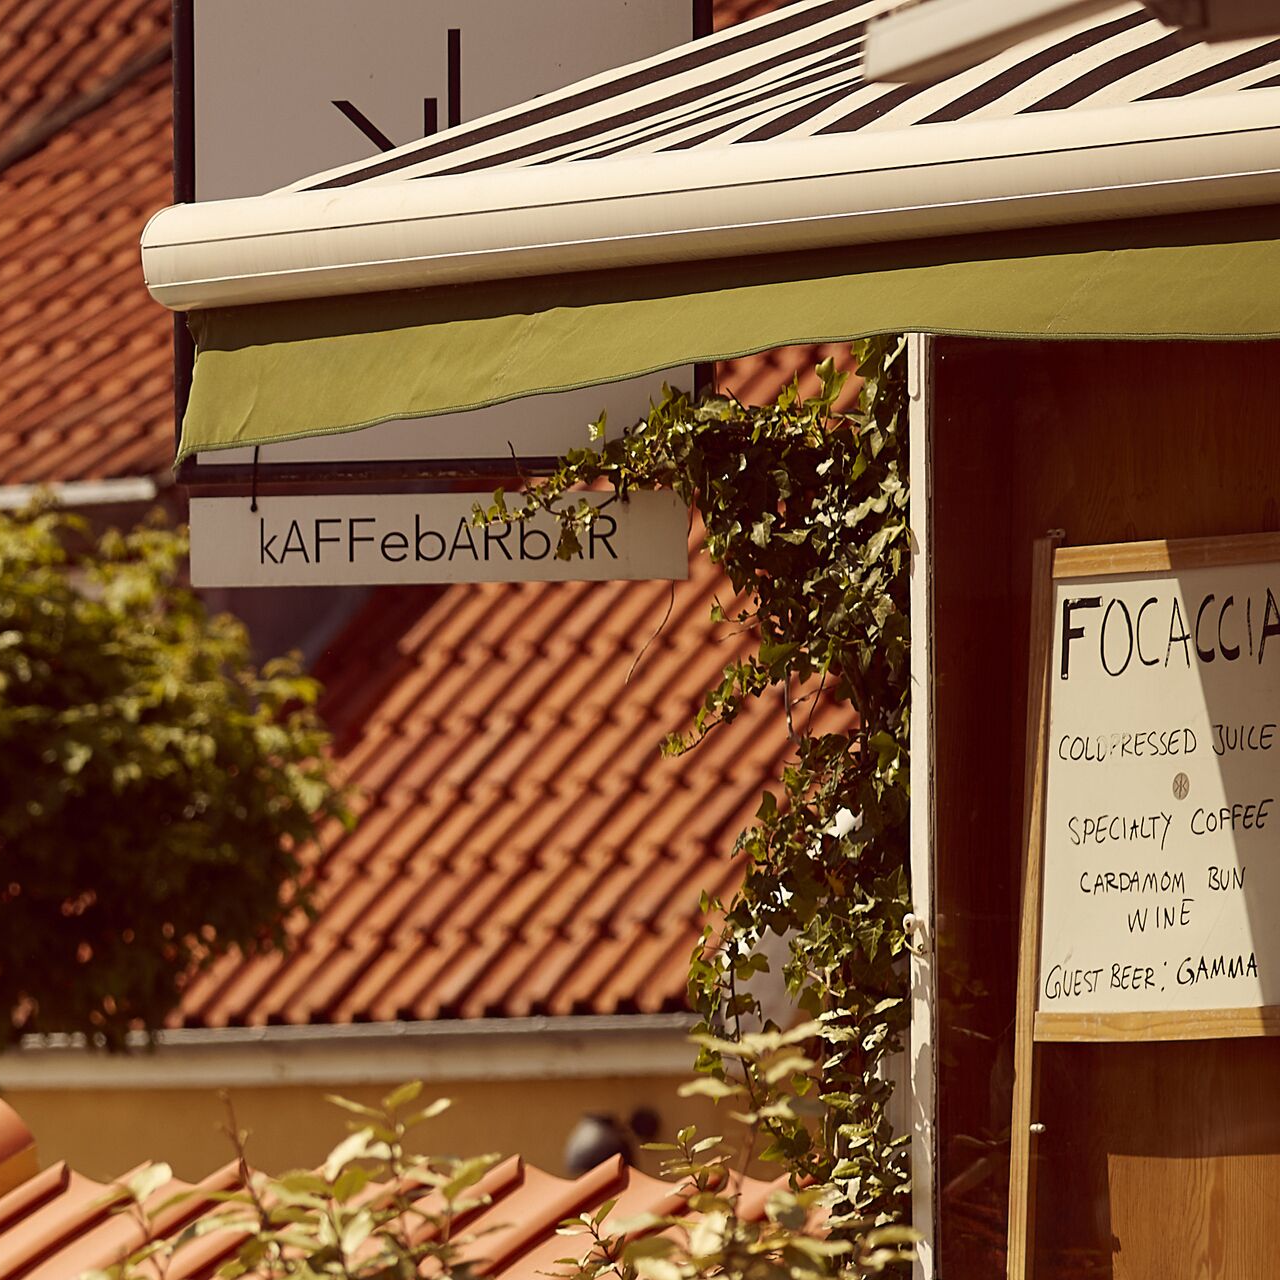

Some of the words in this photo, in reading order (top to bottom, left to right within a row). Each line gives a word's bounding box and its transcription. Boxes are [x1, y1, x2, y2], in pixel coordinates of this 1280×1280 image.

[1060, 587, 1280, 680] FOCACCIA
[1212, 723, 1277, 756] JUICE
[1068, 811, 1172, 850] SPECIALTY
[1190, 798, 1274, 836] COFFEE
[1079, 870, 1185, 896] CARDAMOM
[1207, 865, 1246, 891] BUN
[1127, 898, 1195, 933] WINE
[1044, 964, 1104, 1000] GUEST
[1176, 952, 1258, 986] GAMMA
